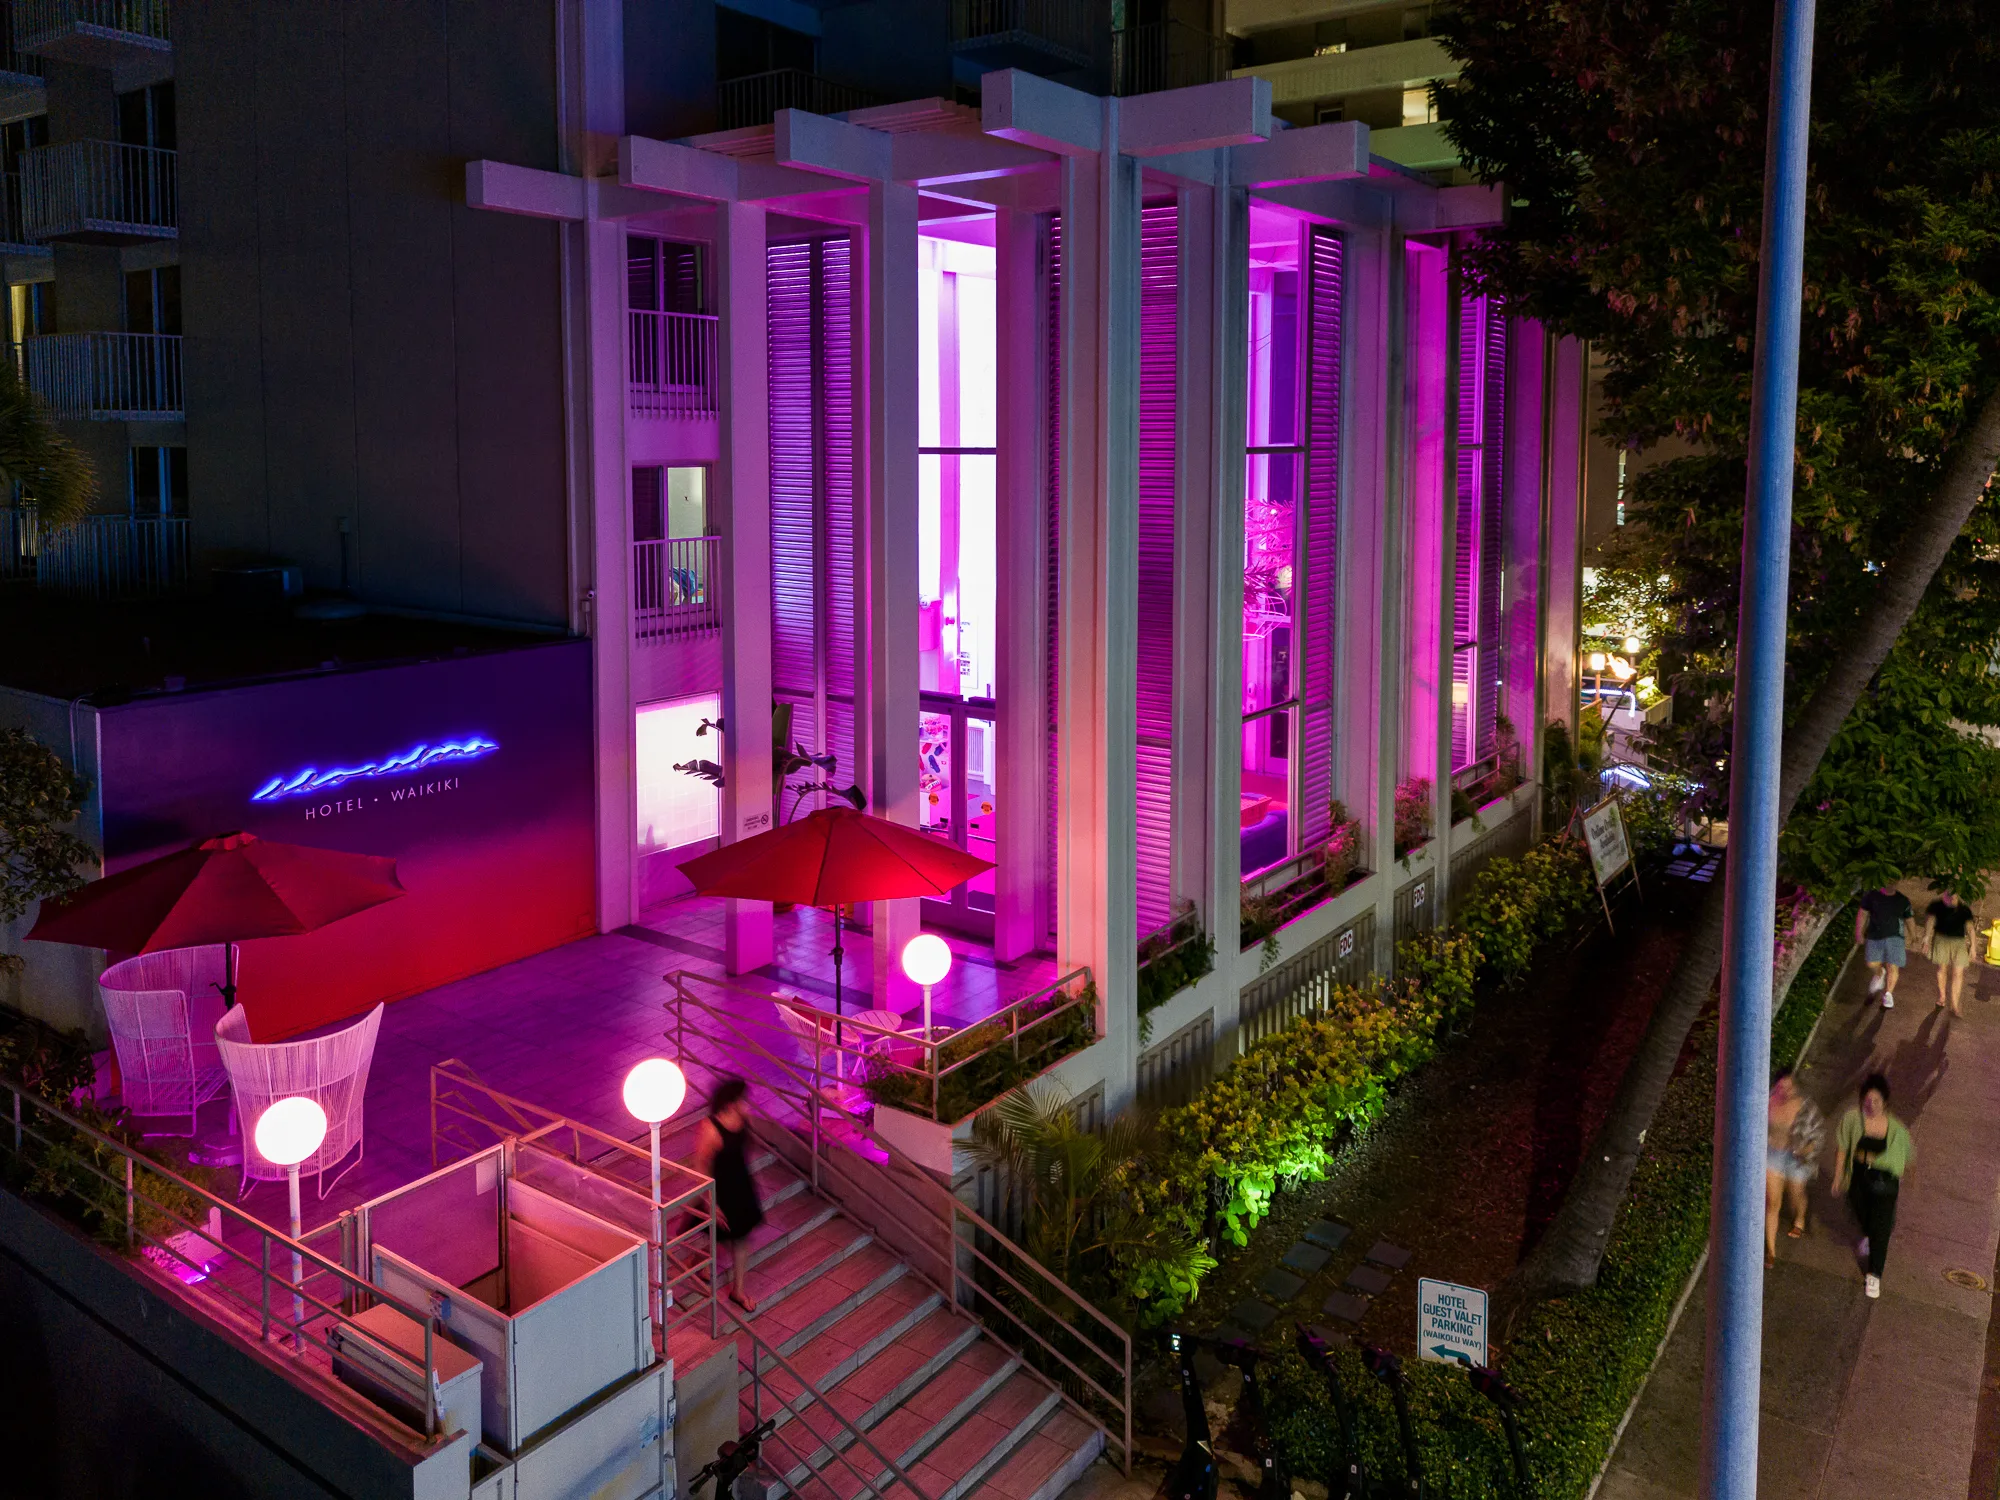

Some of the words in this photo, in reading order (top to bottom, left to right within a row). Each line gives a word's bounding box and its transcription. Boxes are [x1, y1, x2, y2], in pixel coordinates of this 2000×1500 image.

[305, 797, 363, 821] HOTEL
[390, 777, 460, 802] WAIKIKI
[1339, 933, 1352, 954] FDC
[1438, 1294, 1467, 1310] HOTEL
[1423, 1303, 1452, 1319] GUEST
[1454, 1309, 1482, 1326] VALET
[1431, 1317, 1473, 1336] PARKING
[1423, 1329, 1460, 1344] (WAIKOLU
[1462, 1338, 1482, 1351] WAY)
